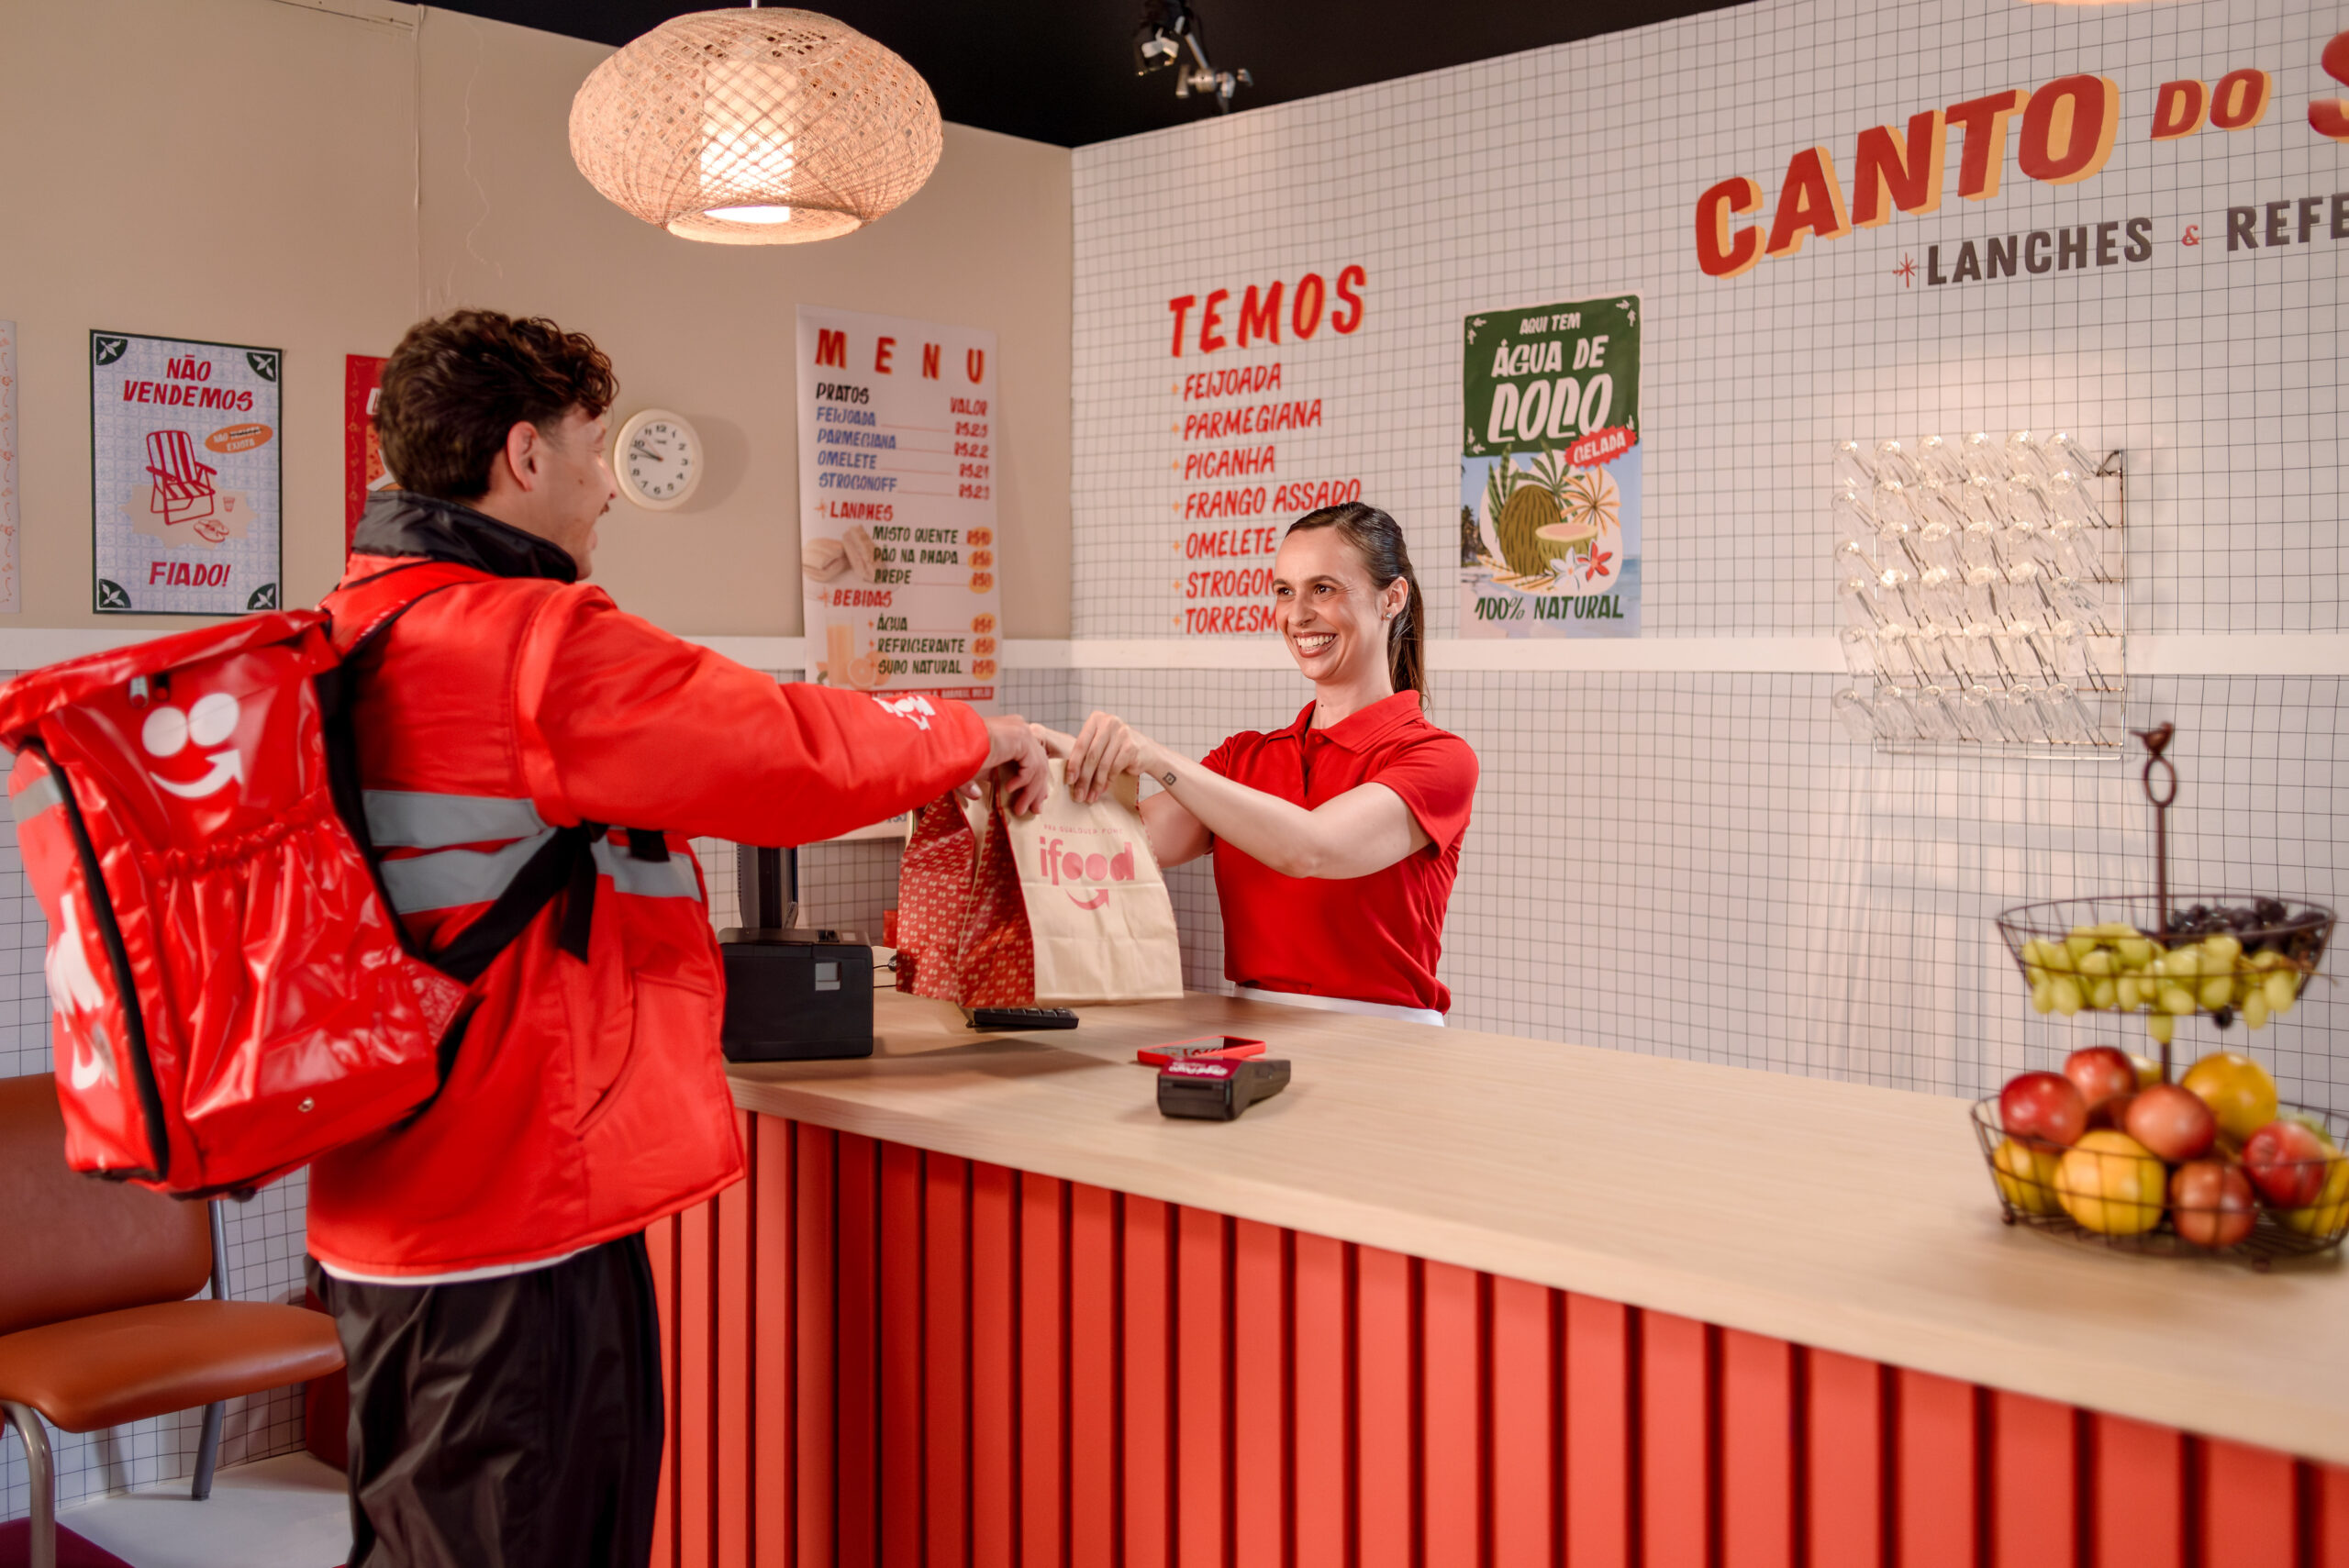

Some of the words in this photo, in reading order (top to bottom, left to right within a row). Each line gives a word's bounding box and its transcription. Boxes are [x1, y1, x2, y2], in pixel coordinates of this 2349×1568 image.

[1696, 73, 2121, 279] CANTO
[2152, 68, 2272, 140] DO
[1928, 217, 2153, 285] LANCHES
[2182, 224, 2199, 246] &
[1169, 264, 1365, 358] TEMOS
[1520, 316, 1548, 334] AQUI
[1552, 312, 1581, 331] TEM
[166, 354, 211, 381] NÃO
[815, 328, 985, 384] MENU
[1491, 339, 1563, 377] ÁGUA
[1573, 336, 1609, 369] DE
[817, 383, 870, 405] PRATOS
[1185, 363, 1281, 401] FEIJOADA
[123, 380, 253, 411] VENDEMOS
[951, 397, 987, 417] VALOR
[817, 406, 876, 427] FEIJOADA
[1185, 399, 1321, 440] PARMEGIANA
[817, 428, 896, 450] PARMEGIANA
[818, 450, 876, 470] OMELETE
[1185, 446, 1275, 480] PICANHA
[819, 473, 897, 493] STROGONOFF
[1186, 487, 1265, 519] FRANGO
[1274, 479, 1361, 513] ASSADO
[873, 526, 909, 541] MISTO
[915, 528, 958, 544] QUENTE
[1186, 527, 1276, 560] OMELETE
[874, 545, 896, 562] PÃO
[900, 550, 914, 562] NA
[149, 562, 231, 587] FIADO!
[833, 590, 892, 607] BEBIDAS
[1475, 595, 1525, 621] 100%
[1533, 595, 1623, 619] NATURAL
[877, 614, 907, 631] ÁGUA
[878, 639, 965, 653] REFRIGERANTE
[912, 661, 963, 674] NATURAL
[1040, 836, 1135, 885] ifood
